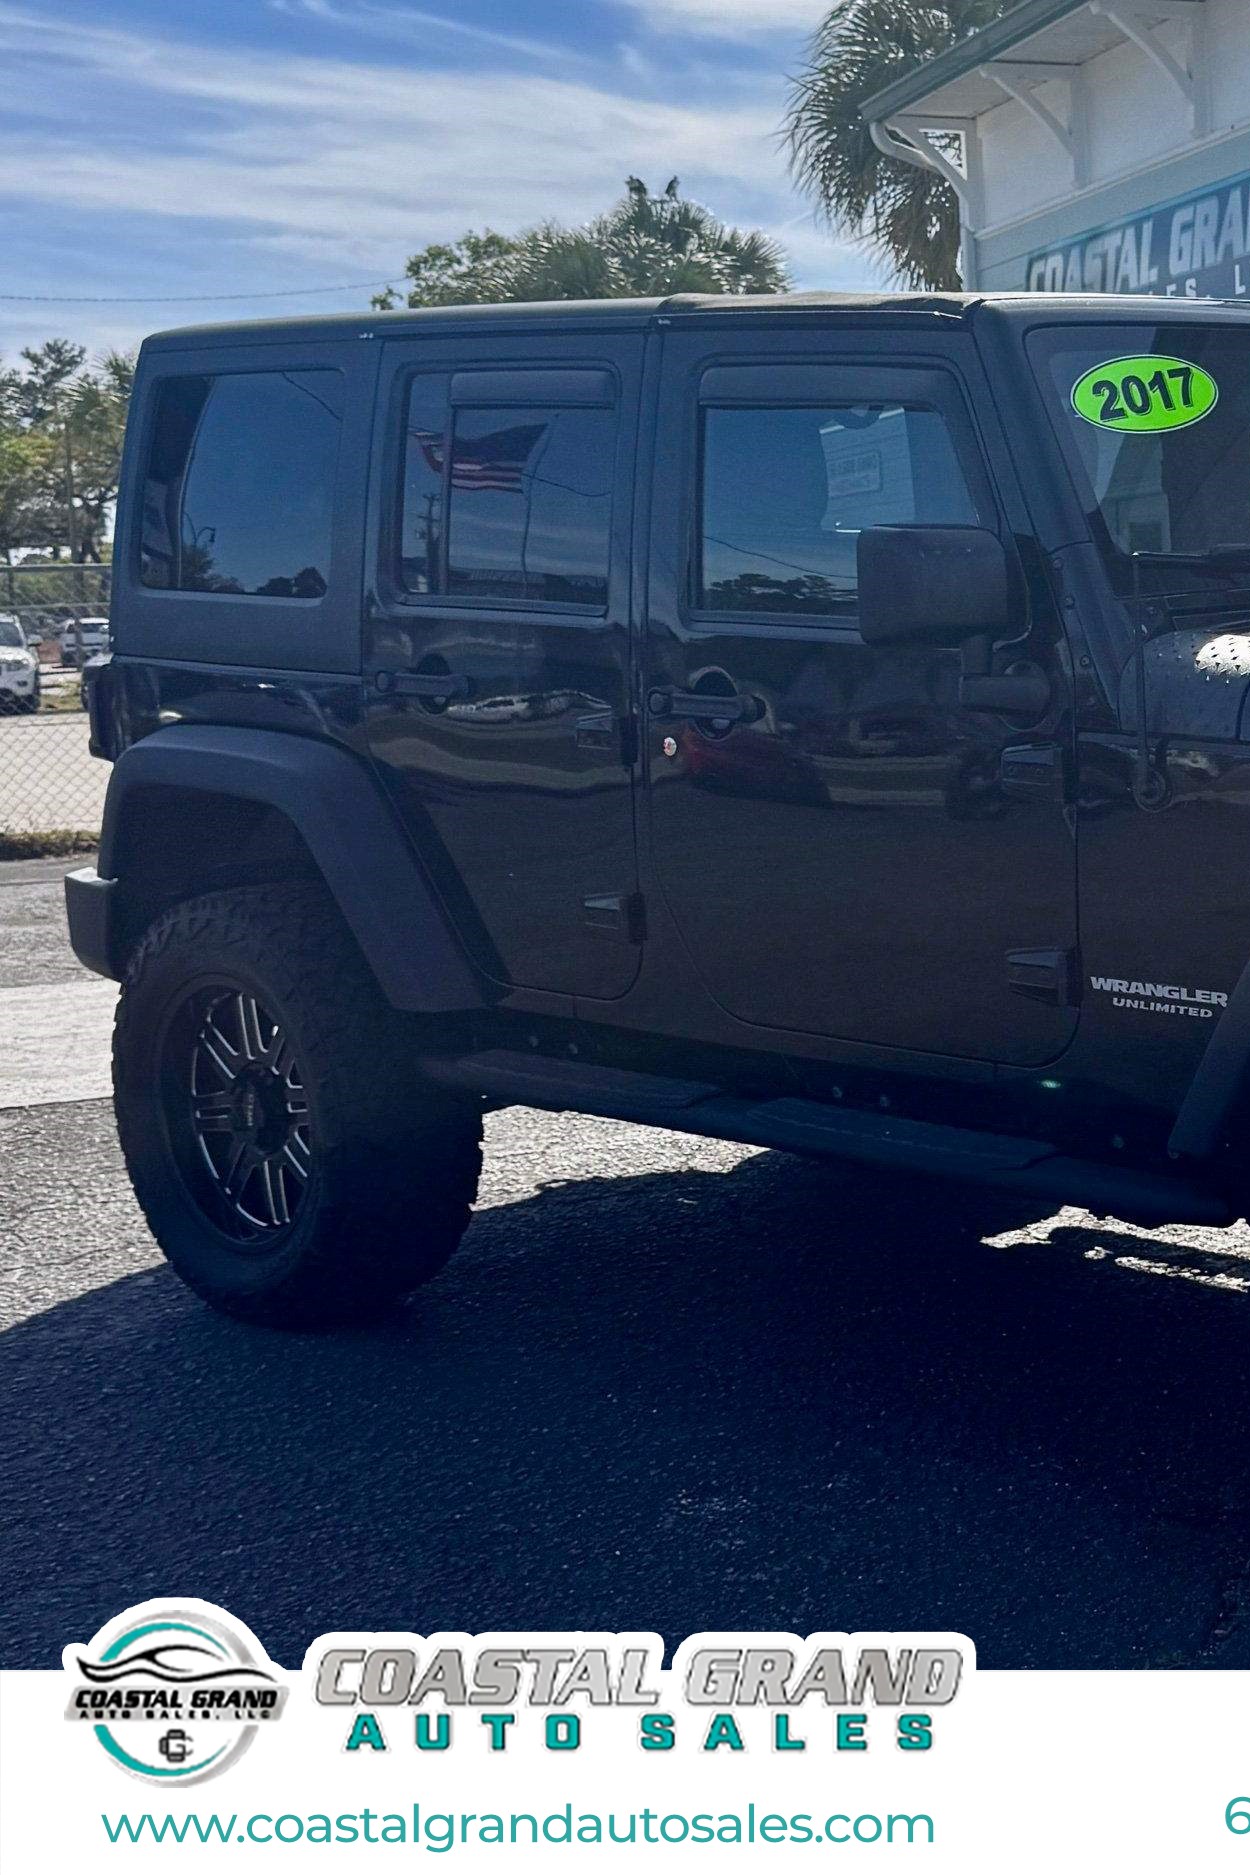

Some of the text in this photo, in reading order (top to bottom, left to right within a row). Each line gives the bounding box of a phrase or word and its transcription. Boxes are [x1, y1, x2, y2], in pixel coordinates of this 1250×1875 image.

[1092, 367, 1194, 422] 2017
[1090, 976, 1229, 1007] WRANGLER
[1112, 997, 1213, 1018] UNLIMITED
